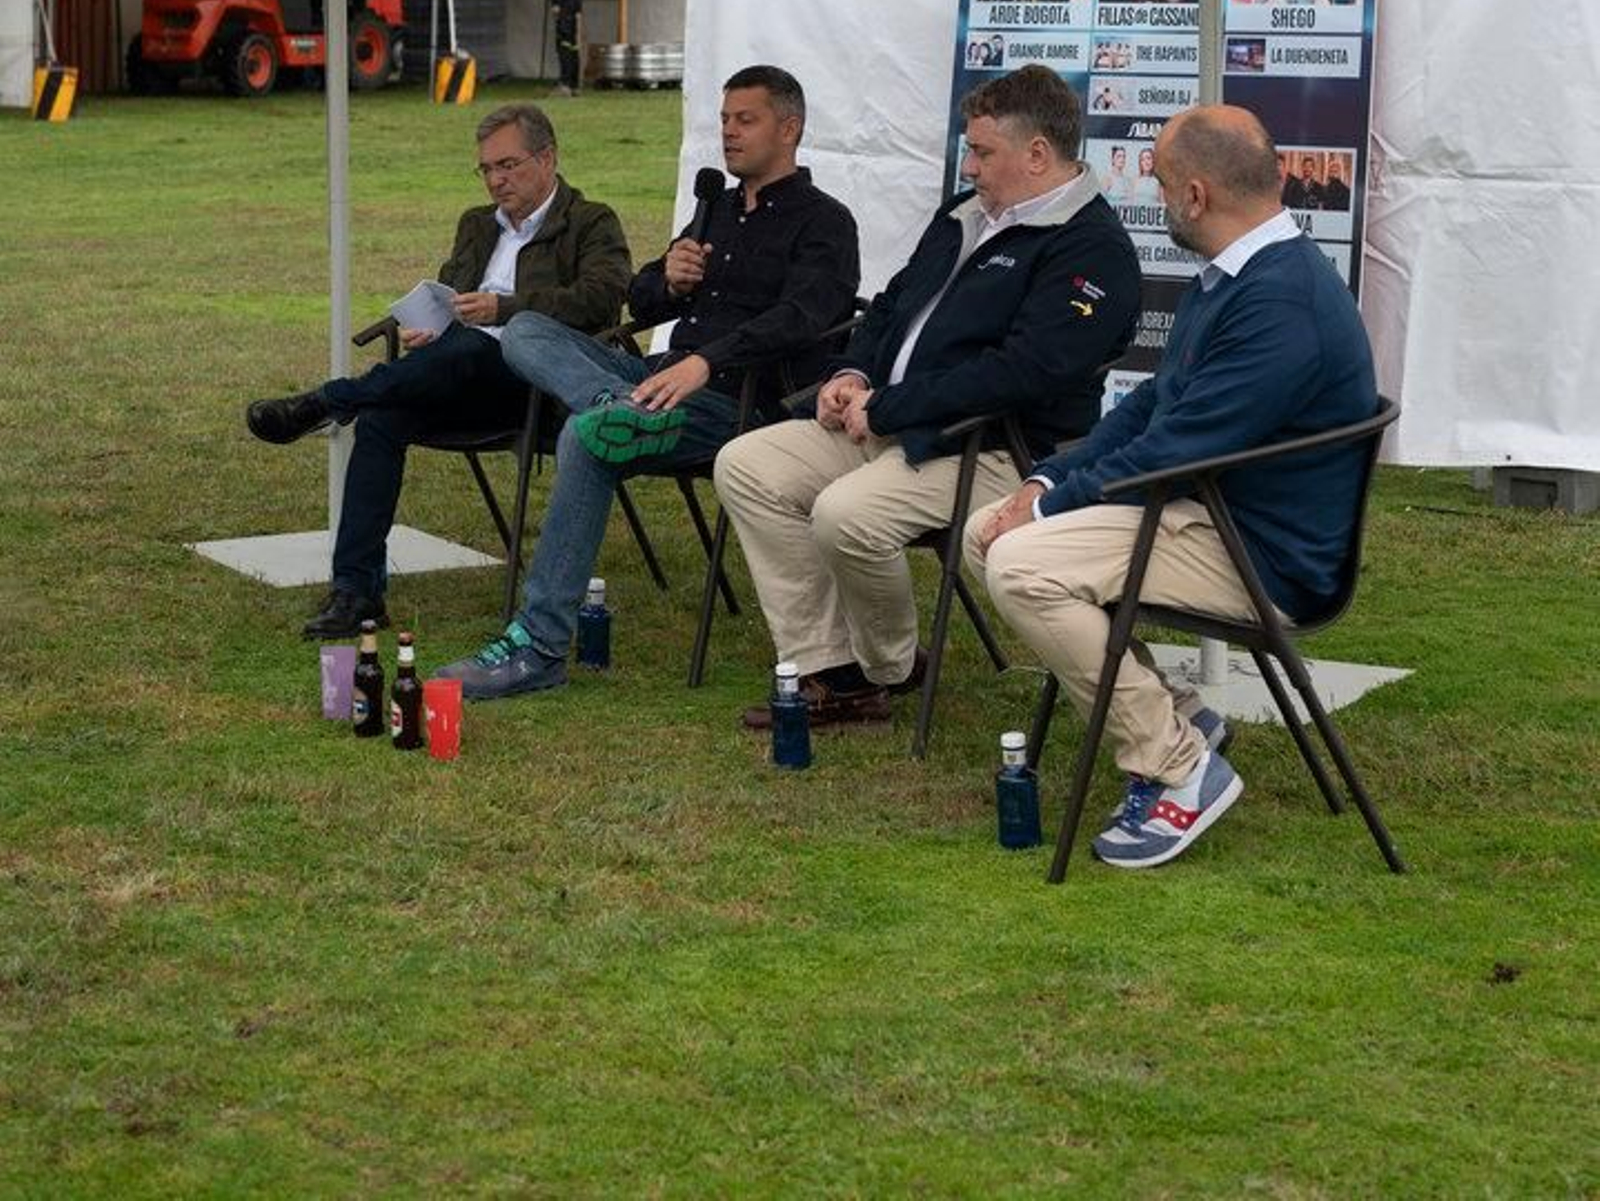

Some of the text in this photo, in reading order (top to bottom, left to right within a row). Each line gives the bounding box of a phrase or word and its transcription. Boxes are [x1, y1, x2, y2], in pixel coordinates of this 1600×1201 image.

[989, 5, 1021, 24] ARDE
[1098, 7, 1134, 26] FILLAS
[1150, 7, 1199, 26] CASSAN
[1271, 7, 1316, 28] SHEGO
[1136, 46, 1155, 61] THE
[1271, 48, 1283, 64] LA
